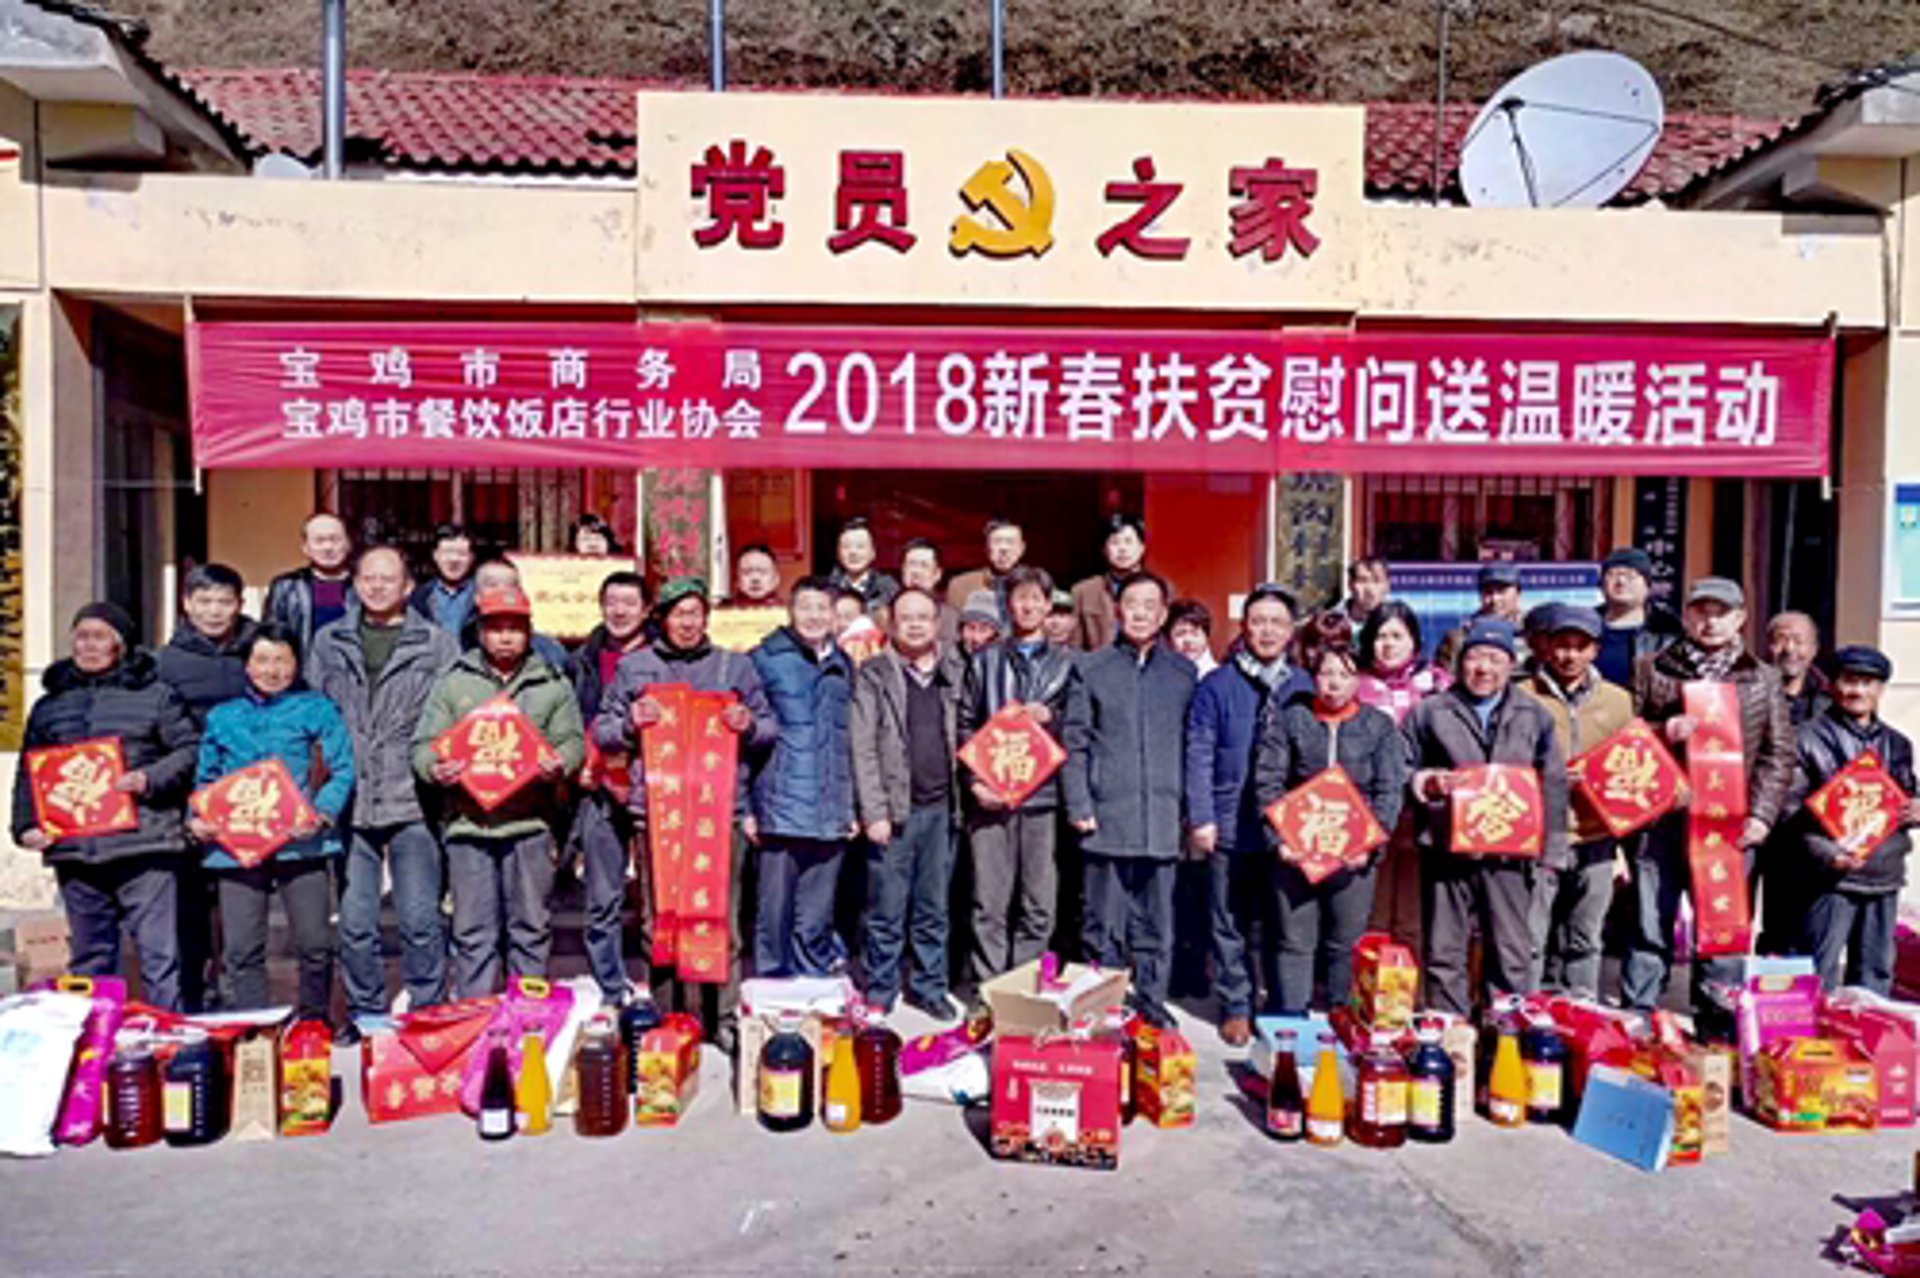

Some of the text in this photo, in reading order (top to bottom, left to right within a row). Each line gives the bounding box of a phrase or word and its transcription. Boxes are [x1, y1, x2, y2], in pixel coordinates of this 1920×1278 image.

[278, 346, 763, 391] 宝鸡市商务局
[281, 397, 763, 441] 宝鸡市餐饮饭店行业协会
[784, 350, 1781, 447] 2018新春扶贫慰问送温暖活动
[987, 728, 1036, 783] 福
[1299, 792, 1350, 857] 福
